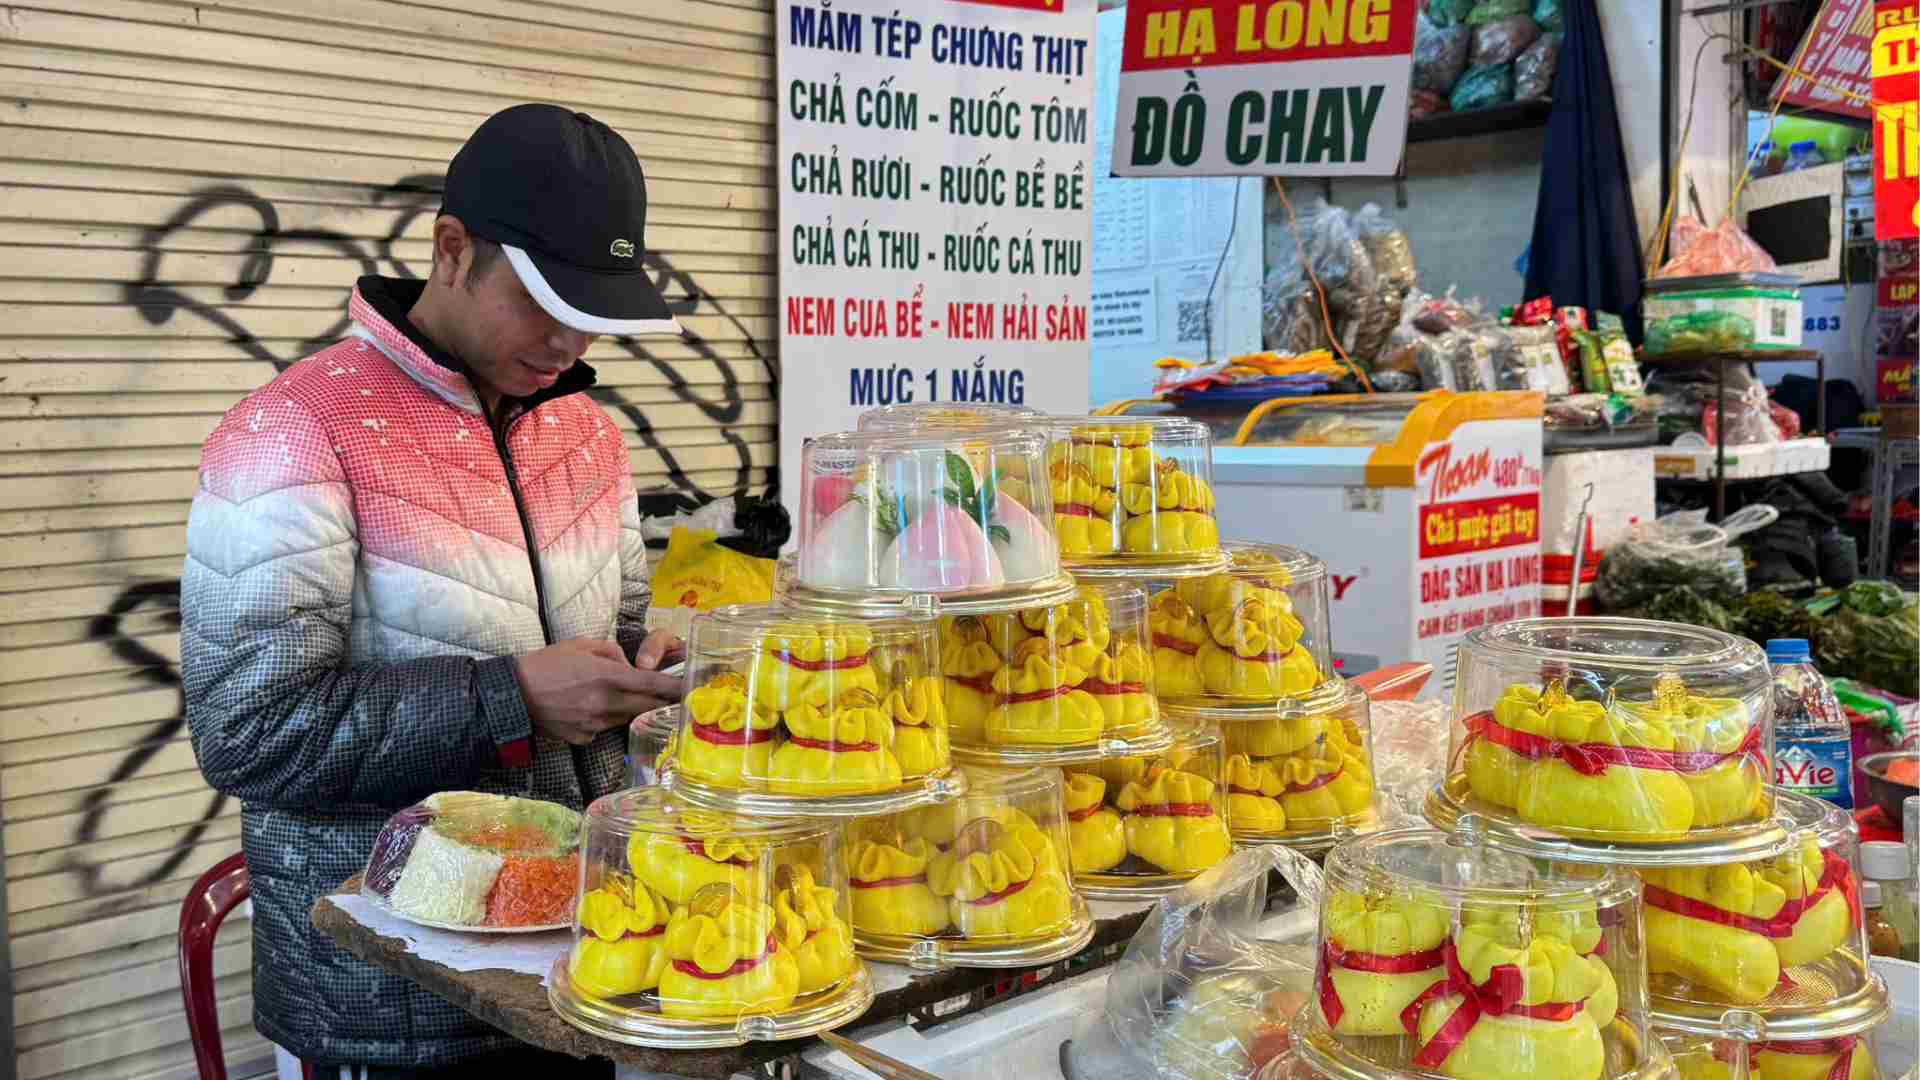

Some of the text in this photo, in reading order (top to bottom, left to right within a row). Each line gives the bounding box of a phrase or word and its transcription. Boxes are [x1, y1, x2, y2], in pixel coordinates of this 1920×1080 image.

[872, 10, 921, 59] TÉP
[932, 24, 1022, 71] CHƯNG
[1033, 35, 1087, 84] THỊT
[1144, 0, 1393, 64] HẠ LONG
[790, 73, 845, 124] CHẢ
[856, 76, 917, 130] CỐM
[950, 88, 1020, 139] RUỐC
[1031, 96, 1087, 145] TÔM
[1131, 70, 1386, 166] ĐỒ CHAY
[792, 145, 842, 195] CHẢ
[940, 154, 1005, 206] RUỐC
[793, 216, 835, 265] CHẢ
[844, 220, 871, 267] CÁ
[879, 231, 919, 270] THU
[944, 223, 1000, 273] RUỐC
[1009, 229, 1034, 274] CÁ
[1042, 240, 1081, 276] THU
[788, 296, 834, 336] NEM
[844, 298, 887, 337] CUA
[948, 303, 993, 339] NEM
[1003, 294, 1037, 340] HẢI
[1046, 295, 1085, 341] SẢN
[926, 369, 936, 402] 1
[952, 355, 1025, 404] NẮNG
[1421, 565, 1451, 608] ĐẶC
[1455, 557, 1482, 597] SẢN
[1508, 555, 1539, 587] LONG
